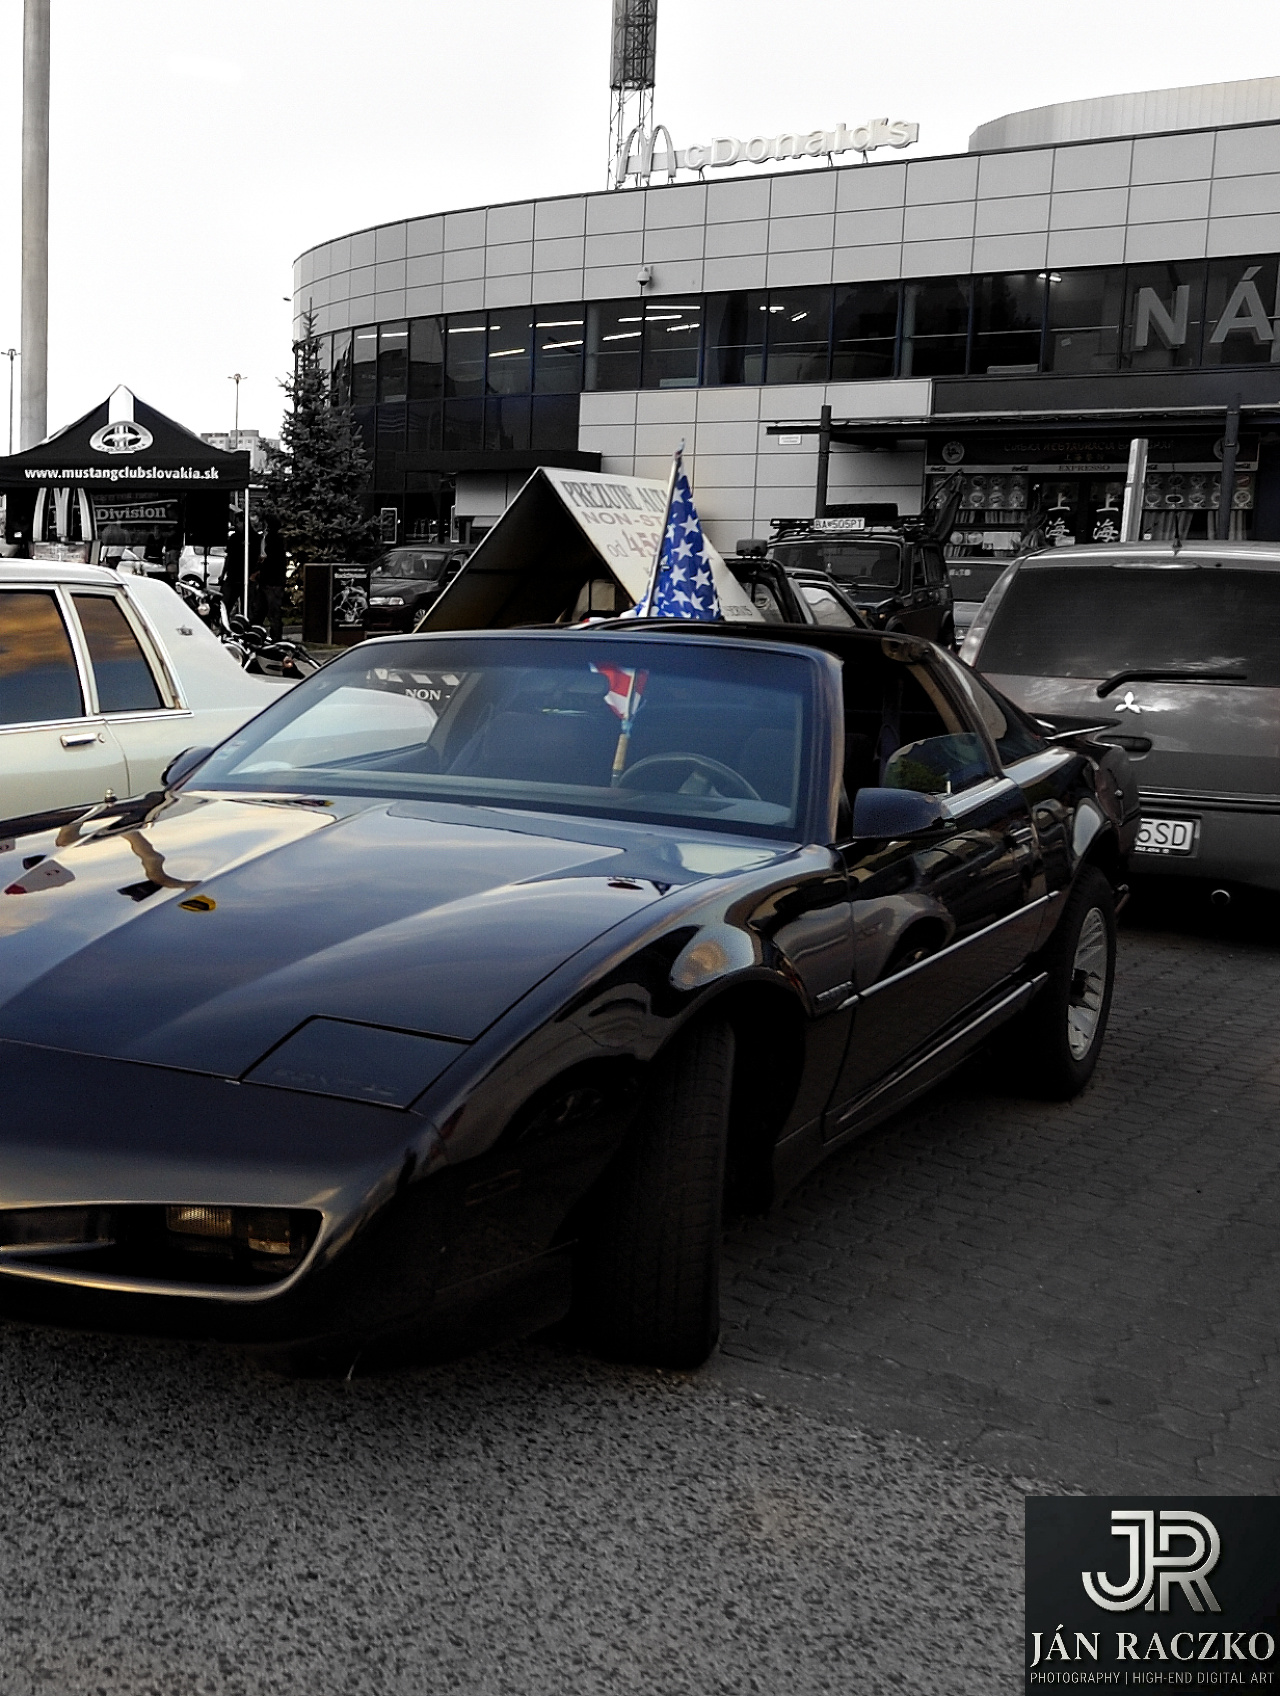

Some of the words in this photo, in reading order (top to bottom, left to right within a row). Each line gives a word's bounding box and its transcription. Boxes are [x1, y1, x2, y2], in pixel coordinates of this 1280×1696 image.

[1134, 265, 1275, 348] NÁ
[24, 466, 219, 482] www.mustangclubslovakia.sk
[95, 506, 167, 521] Division
[405, 688, 442, 701] NON
